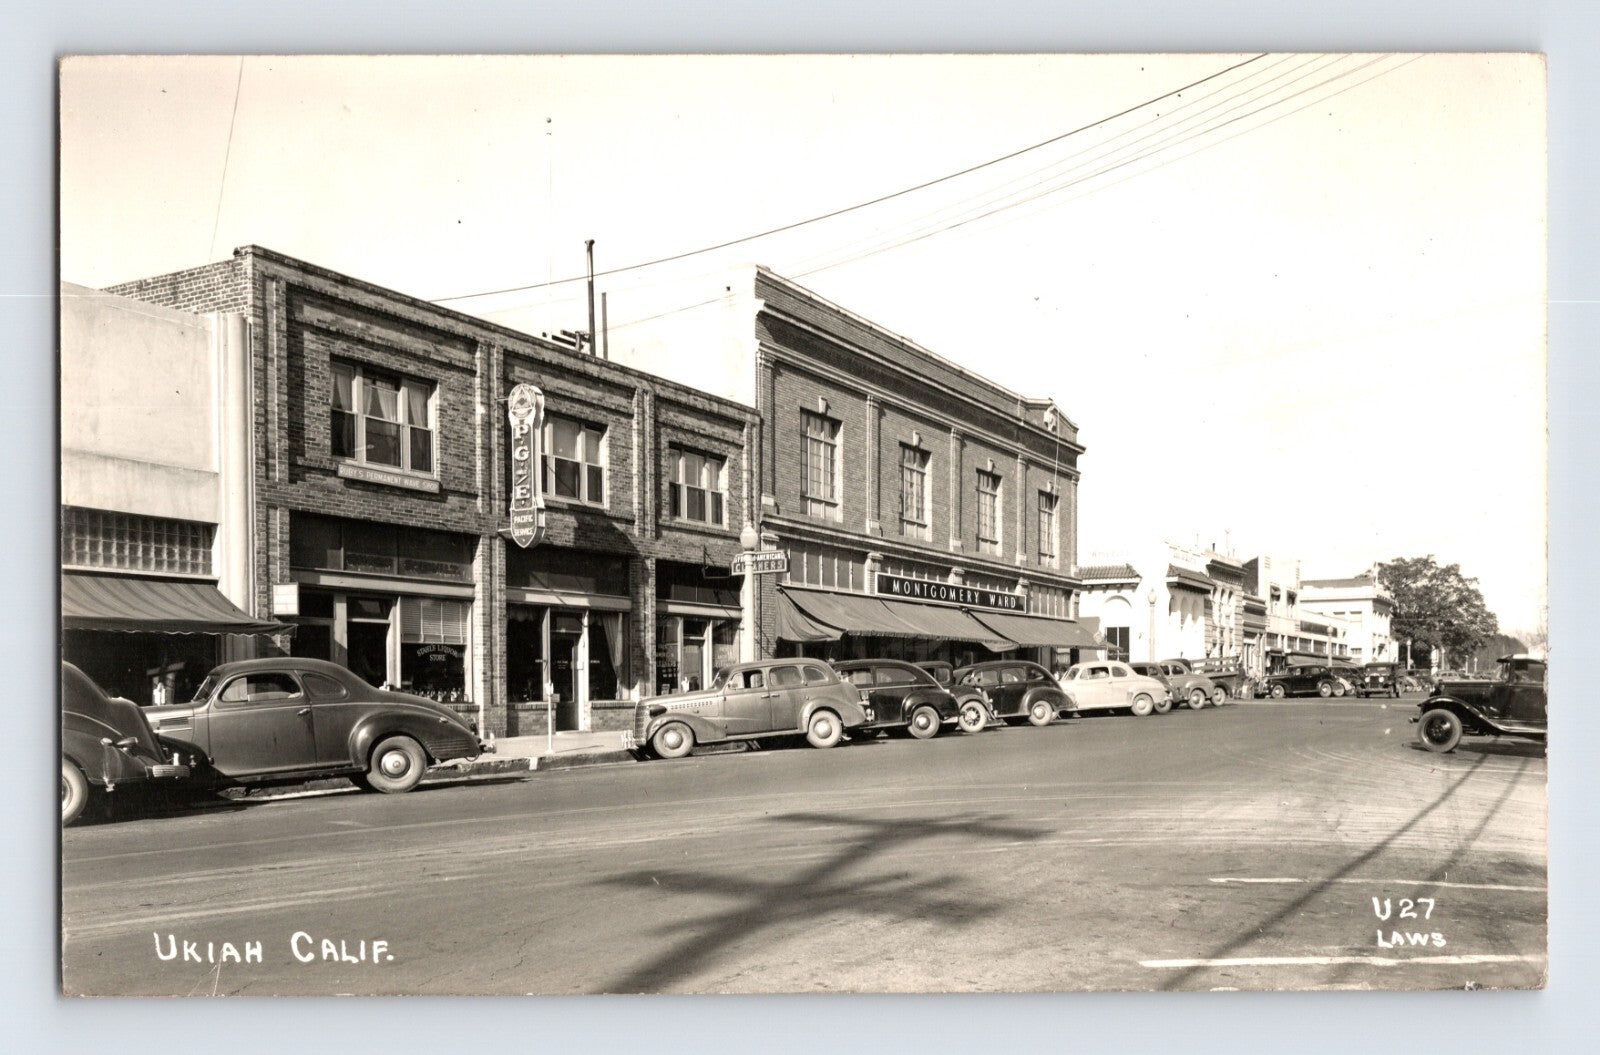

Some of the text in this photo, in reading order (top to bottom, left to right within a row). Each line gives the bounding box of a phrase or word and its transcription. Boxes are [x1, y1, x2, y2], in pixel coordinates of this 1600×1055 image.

[366, 471, 401, 484] PERMANENT
[513, 515, 534, 524] PACIFIC
[735, 561, 783, 572] CLANERS
[892, 579, 1017, 609] MONTGOMERY WARD
